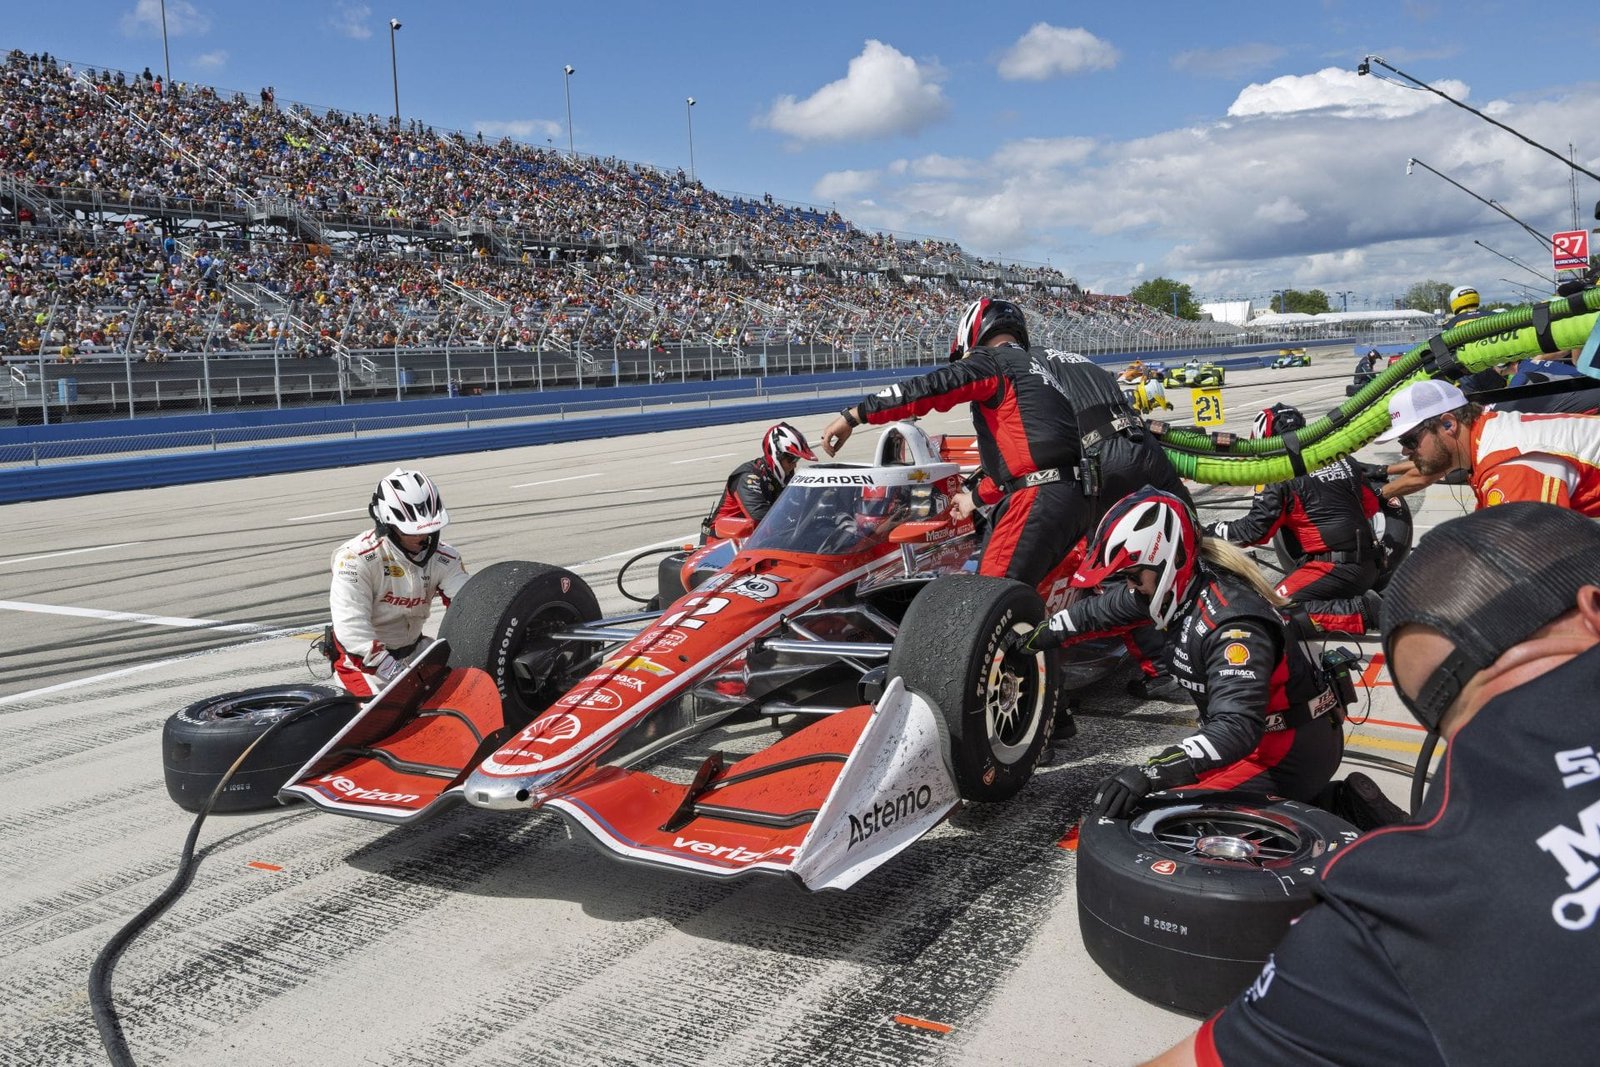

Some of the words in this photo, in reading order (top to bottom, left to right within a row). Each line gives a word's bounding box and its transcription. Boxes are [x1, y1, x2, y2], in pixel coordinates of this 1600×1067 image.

[1555, 235, 1584, 256] 27
[1195, 395, 1221, 422] 21
[319, 774, 420, 803] verizon
[847, 784, 932, 851] Astemo
